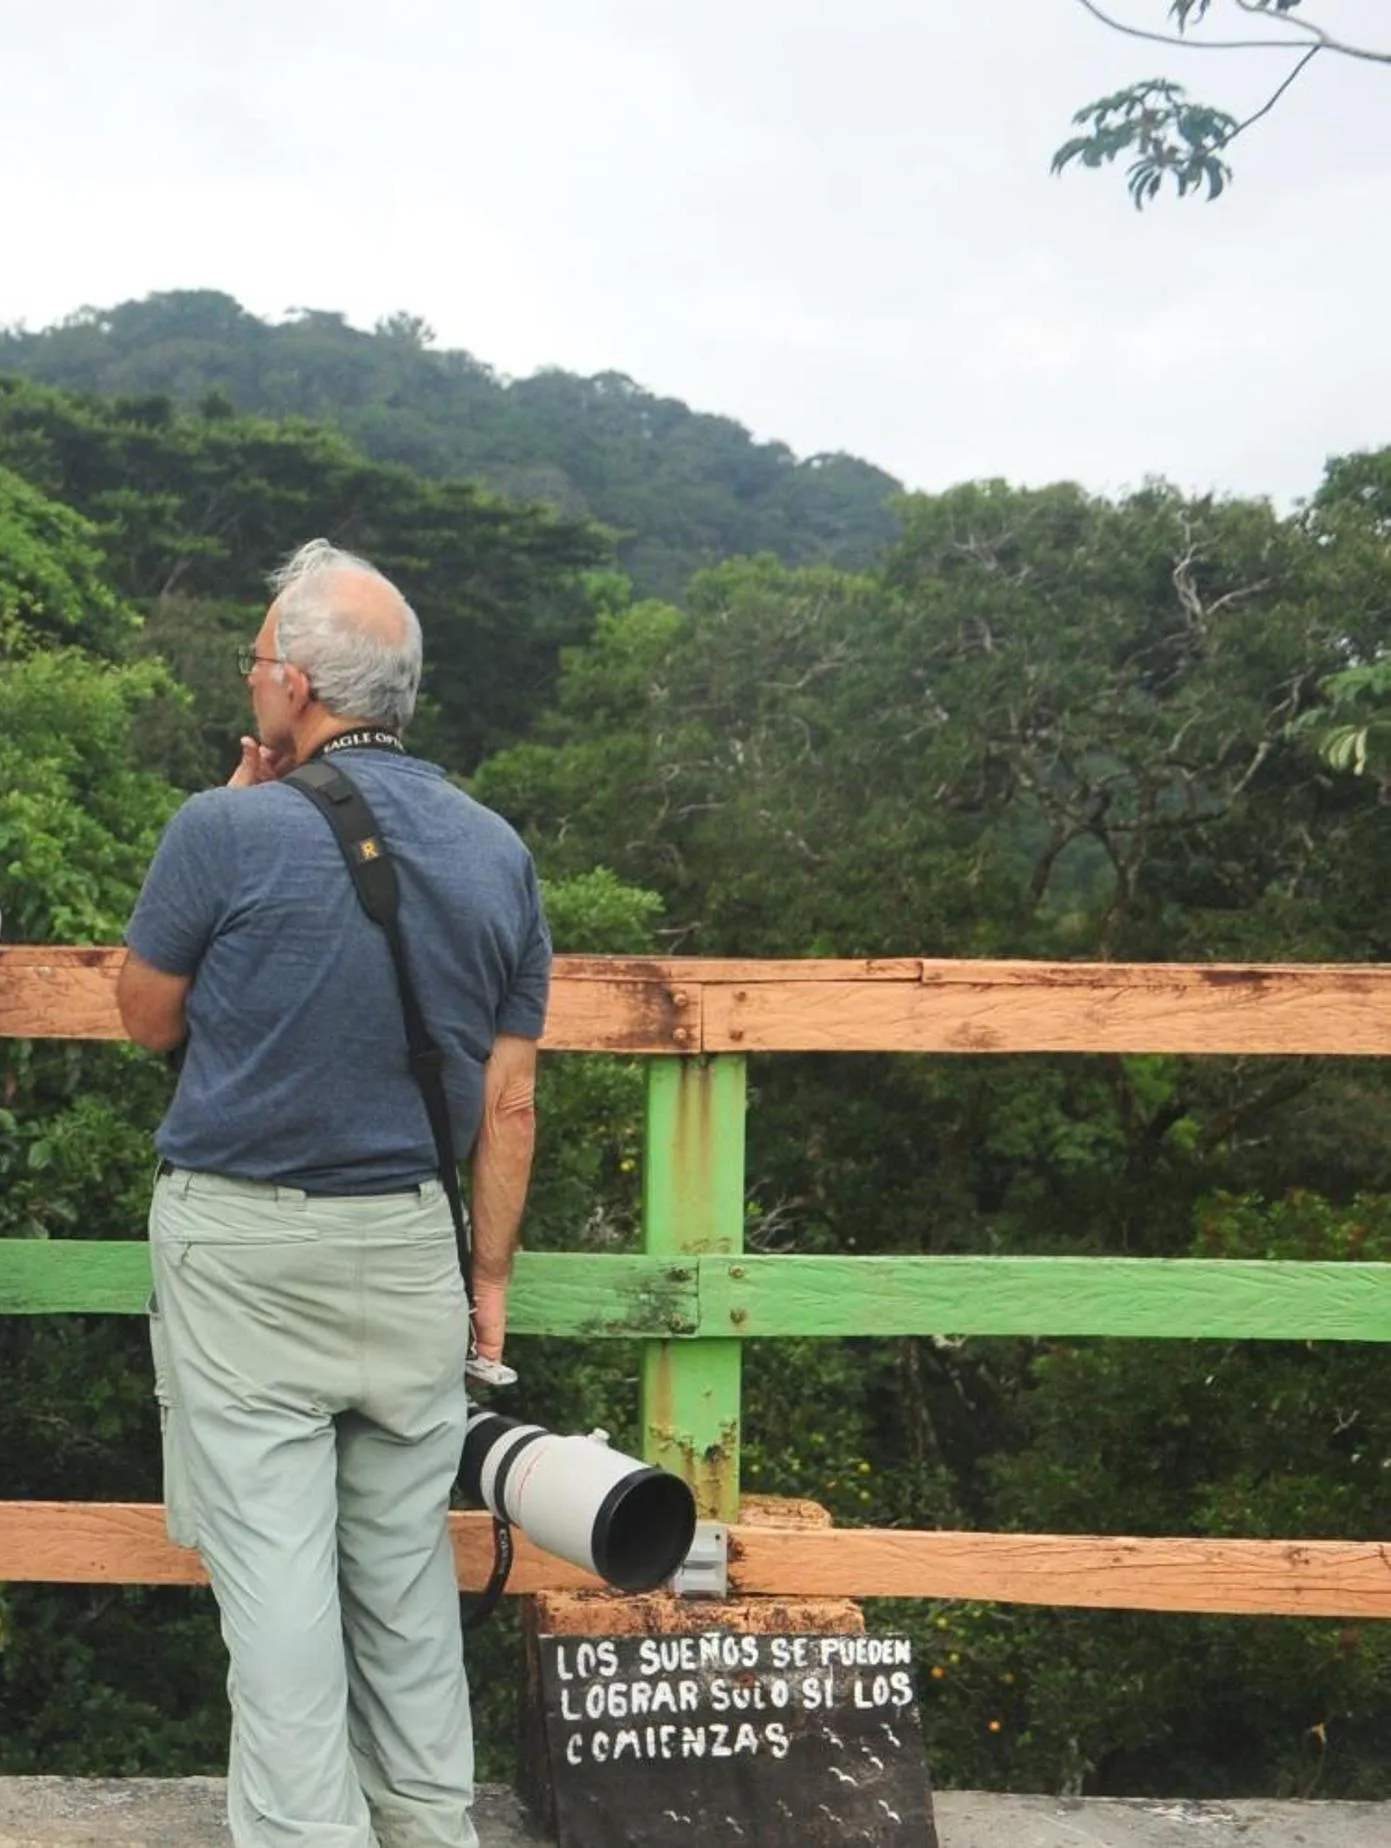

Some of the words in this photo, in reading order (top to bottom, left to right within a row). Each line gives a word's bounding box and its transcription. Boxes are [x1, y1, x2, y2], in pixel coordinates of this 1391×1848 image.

[557, 1641, 619, 1680] LOS
[770, 1637, 808, 1668] SE
[820, 1638, 911, 1667] PUEDEN
[560, 1680, 699, 1721] LOGRAR
[801, 1674, 834, 1709] SI
[854, 1671, 913, 1709] LOS
[566, 1722, 790, 1765] COMIENZAS
